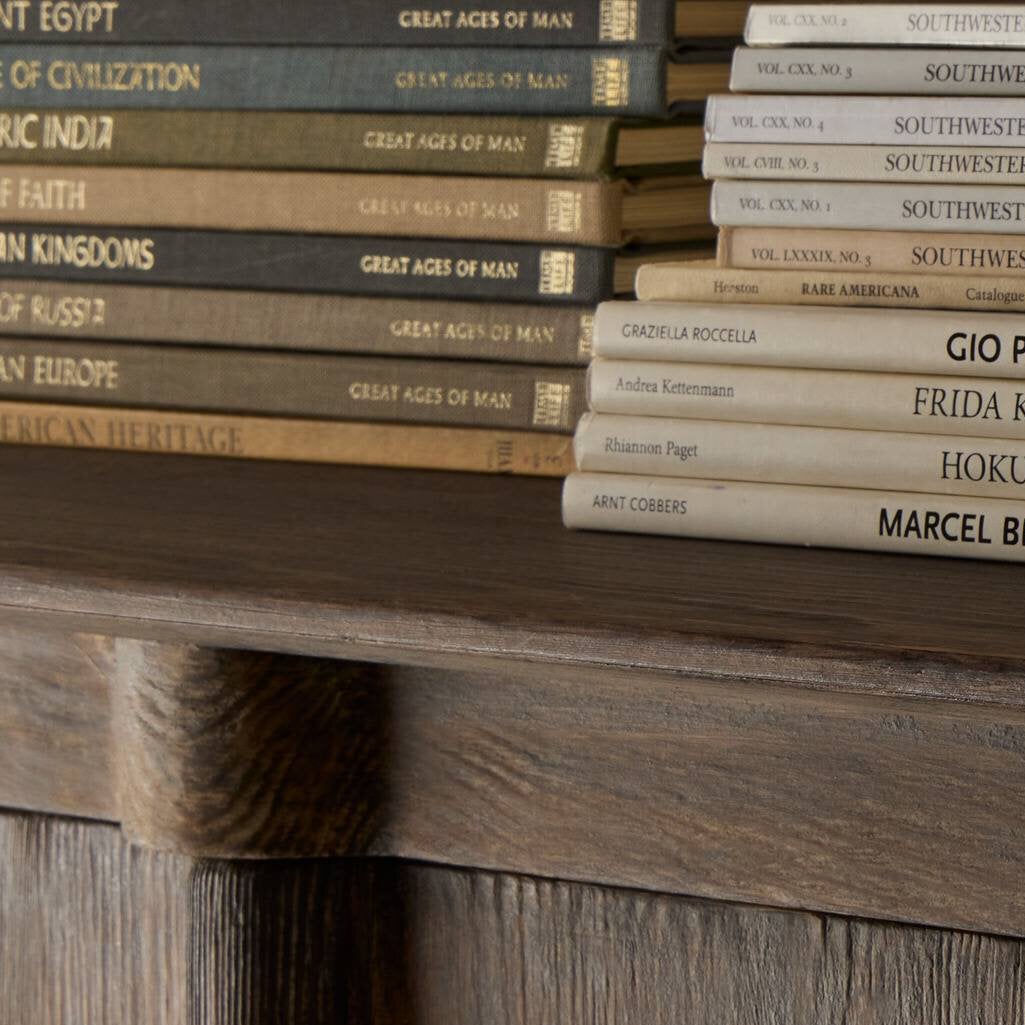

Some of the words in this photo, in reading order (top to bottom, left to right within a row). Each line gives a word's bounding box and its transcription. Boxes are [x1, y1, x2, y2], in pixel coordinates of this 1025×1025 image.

[40, 1, 119, 32] EGYPT
[398, 10, 451, 28] GREAT
[457, 12, 499, 29] AGES
[504, 12, 528, 29] OF
[532, 12, 574, 29] MAN
[10, 60, 42, 90] OF
[395, 71, 447, 88] GREAT
[454, 72, 495, 89] AGES
[501, 73, 521, 90] OF
[527, 73, 569, 90] MAN
[821, 64, 843, 76] NO.
[43, 115, 113, 150] INDIA
[794, 117, 815, 129] NO.
[817, 120, 824, 132] 4
[363, 130, 413, 149] GREAT
[419, 132, 457, 150] AGES
[461, 134, 483, 151] OF
[488, 135, 527, 153] MAN
[788, 158, 810, 169] NO.
[813, 161, 820, 172] 3
[17, 178, 87, 211] FAITH
[801, 200, 823, 212] NO.
[457, 203, 475, 218] OF
[482, 203, 519, 220] MAN
[32, 234, 155, 271] KINGDOMS
[839, 251, 862, 263] NO.
[865, 256, 871, 267] 3
[360, 255, 410, 273] GREAT
[412, 257, 452, 276] AGES
[456, 259, 477, 278] OF
[481, 261, 519, 279] MAN
[802, 283, 836, 295] RARE
[839, 284, 919, 298] AMERICANA
[966, 288, 1024, 304] Catalogue
[390, 320, 439, 338] GREAT
[491, 325, 512, 341] OF
[517, 325, 555, 343] MAN
[622, 323, 688, 340] GRAZIELLA
[693, 328, 757, 343] ROCCELLA
[946, 332, 1001, 362] GIO
[33, 356, 119, 389] EUROPE
[350, 382, 399, 401] GREAT
[404, 385, 443, 405] AGES
[449, 388, 471, 406] OF
[474, 391, 512, 409] MAN
[615, 377, 658, 394] Andrea
[662, 379, 734, 398] Kettenmann
[913, 387, 1003, 420] FRIDA
[108, 418, 244, 456] HERITAGE
[605, 437, 662, 455] Rhiannon
[666, 441, 698, 461] Paget
[592, 495, 626, 510] ARNT
[630, 498, 687, 514] COBBERS
[878, 508, 992, 544] MARCEL
